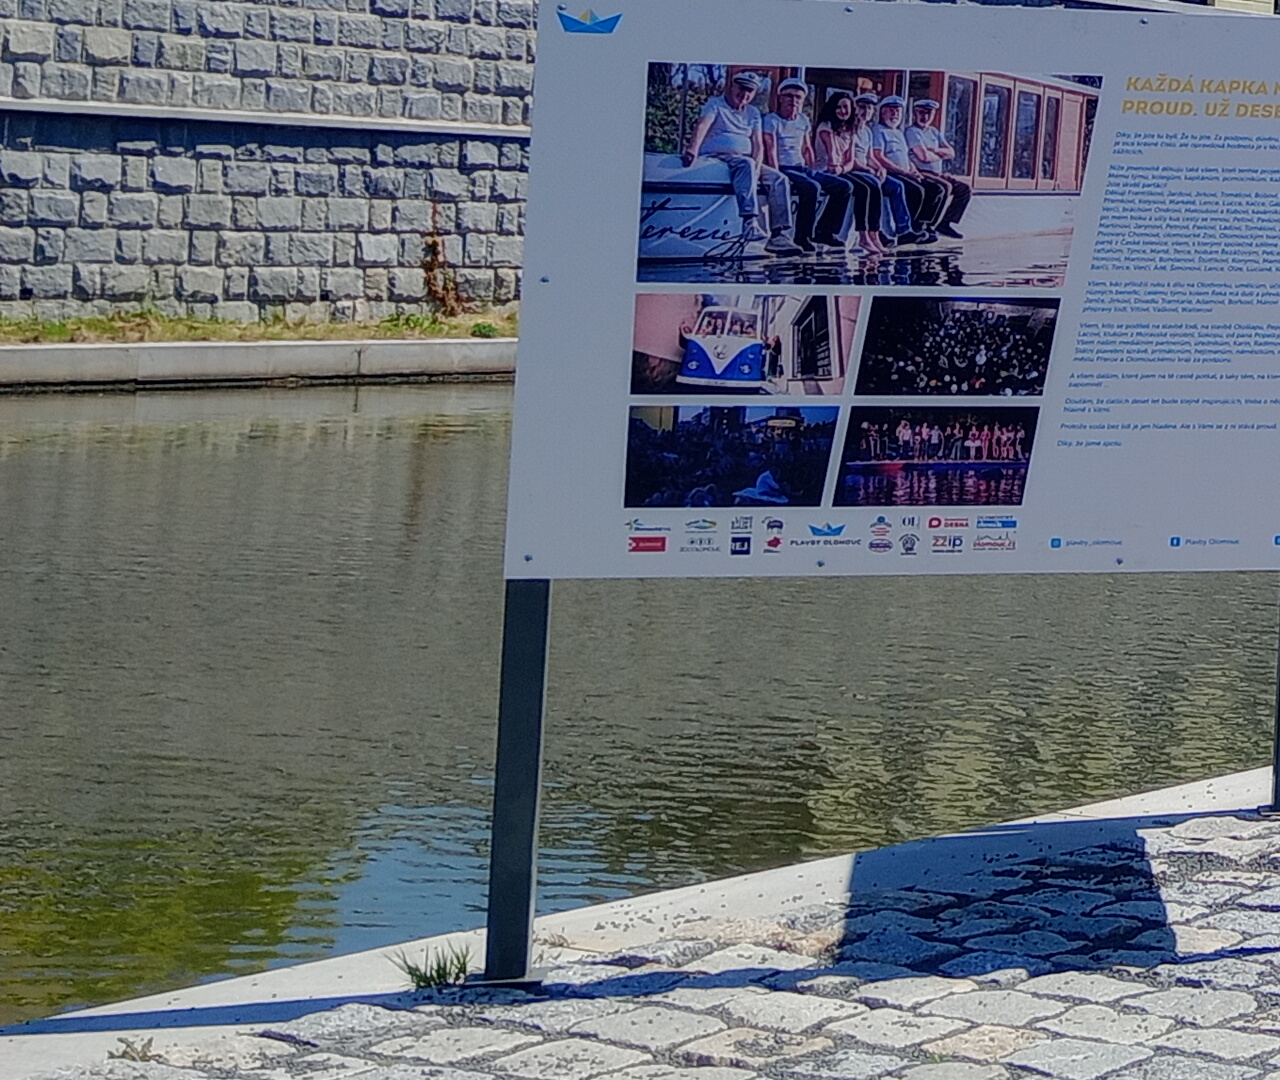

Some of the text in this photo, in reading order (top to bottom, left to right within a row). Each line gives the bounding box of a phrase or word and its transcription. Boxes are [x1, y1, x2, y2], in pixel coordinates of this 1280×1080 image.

[1126, 73, 1195, 94] KAŽDÁ
[1199, 79, 1268, 96] KAPKA
[1121, 100, 1198, 117] PROUD.
[1204, 98, 1230, 118] UŽ
[823, 538, 861, 546] OLOMOUC
